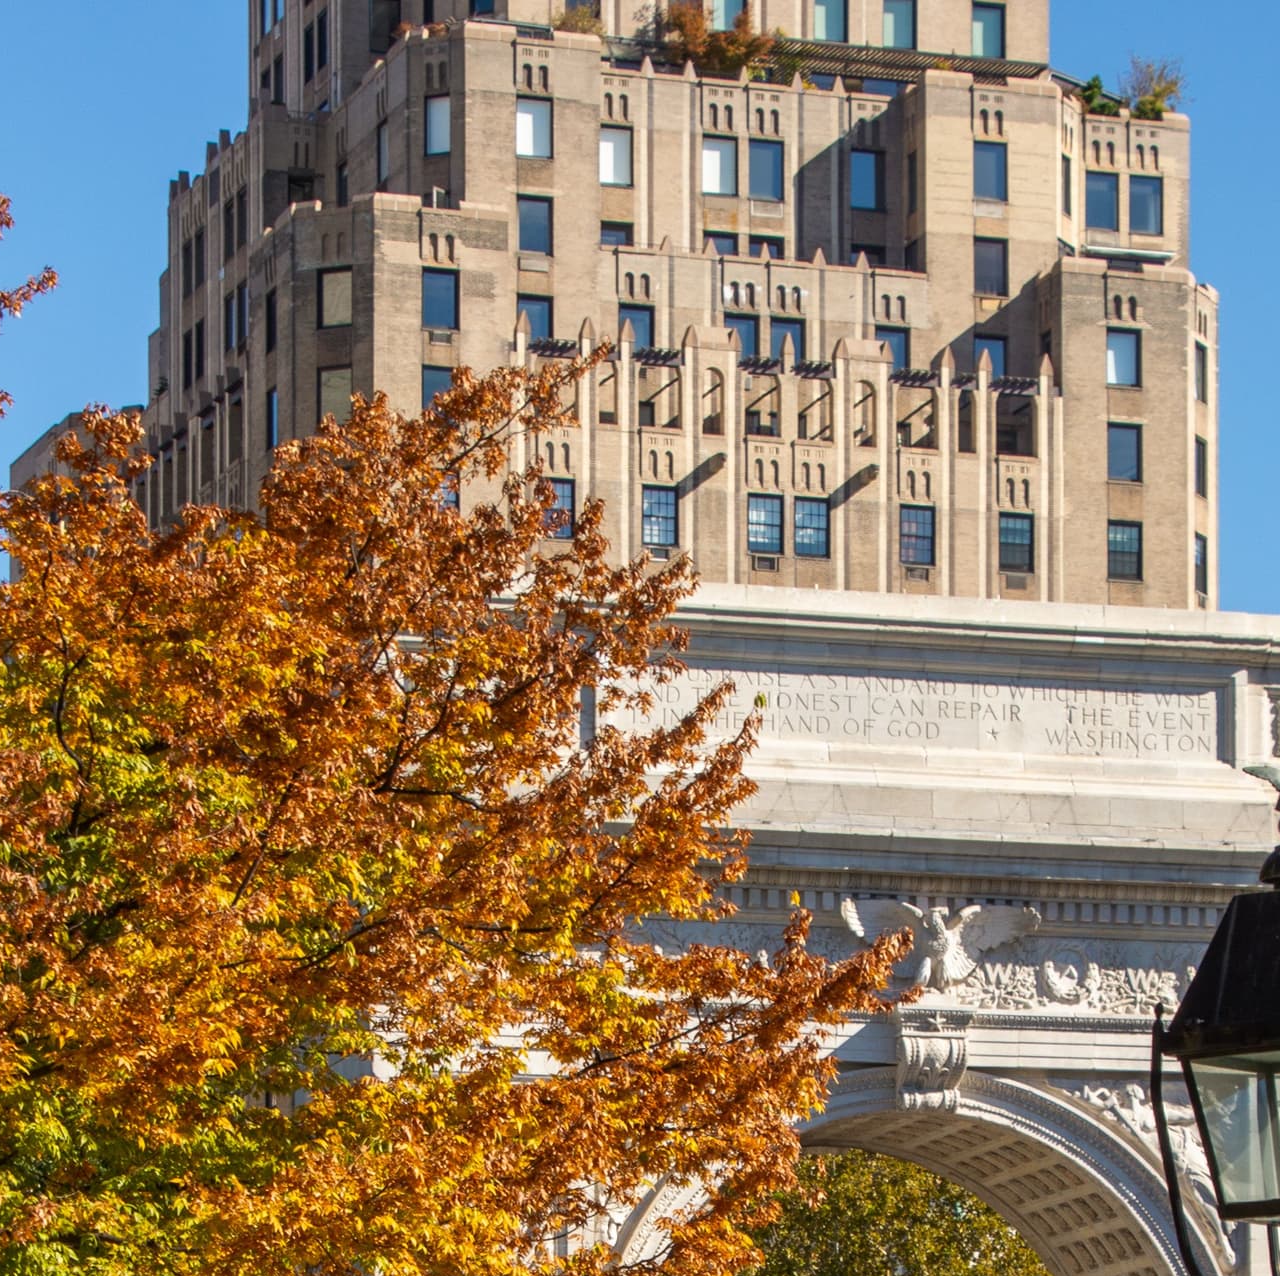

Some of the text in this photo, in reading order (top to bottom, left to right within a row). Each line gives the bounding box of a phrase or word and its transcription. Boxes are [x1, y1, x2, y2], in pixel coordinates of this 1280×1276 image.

[721, 668, 790, 688] RAISE
[799, 672, 817, 689] A
[826, 674, 956, 697] STANDARD
[970, 680, 1000, 698] TO
[1008, 681, 1088, 704] WHICH
[1101, 688, 1144, 707] THE
[1154, 691, 1211, 710] WISE
[760, 714, 831, 735] HAND
[843, 718, 876, 737] OF
[887, 720, 940, 740] GOD
[1045, 727, 1211, 753] WASHINGTON
[871, 697, 924, 717] CAN
[938, 700, 1022, 722] REPAIR
[1066, 705, 1113, 727] THE
[1128, 710, 1211, 732] EVENT
